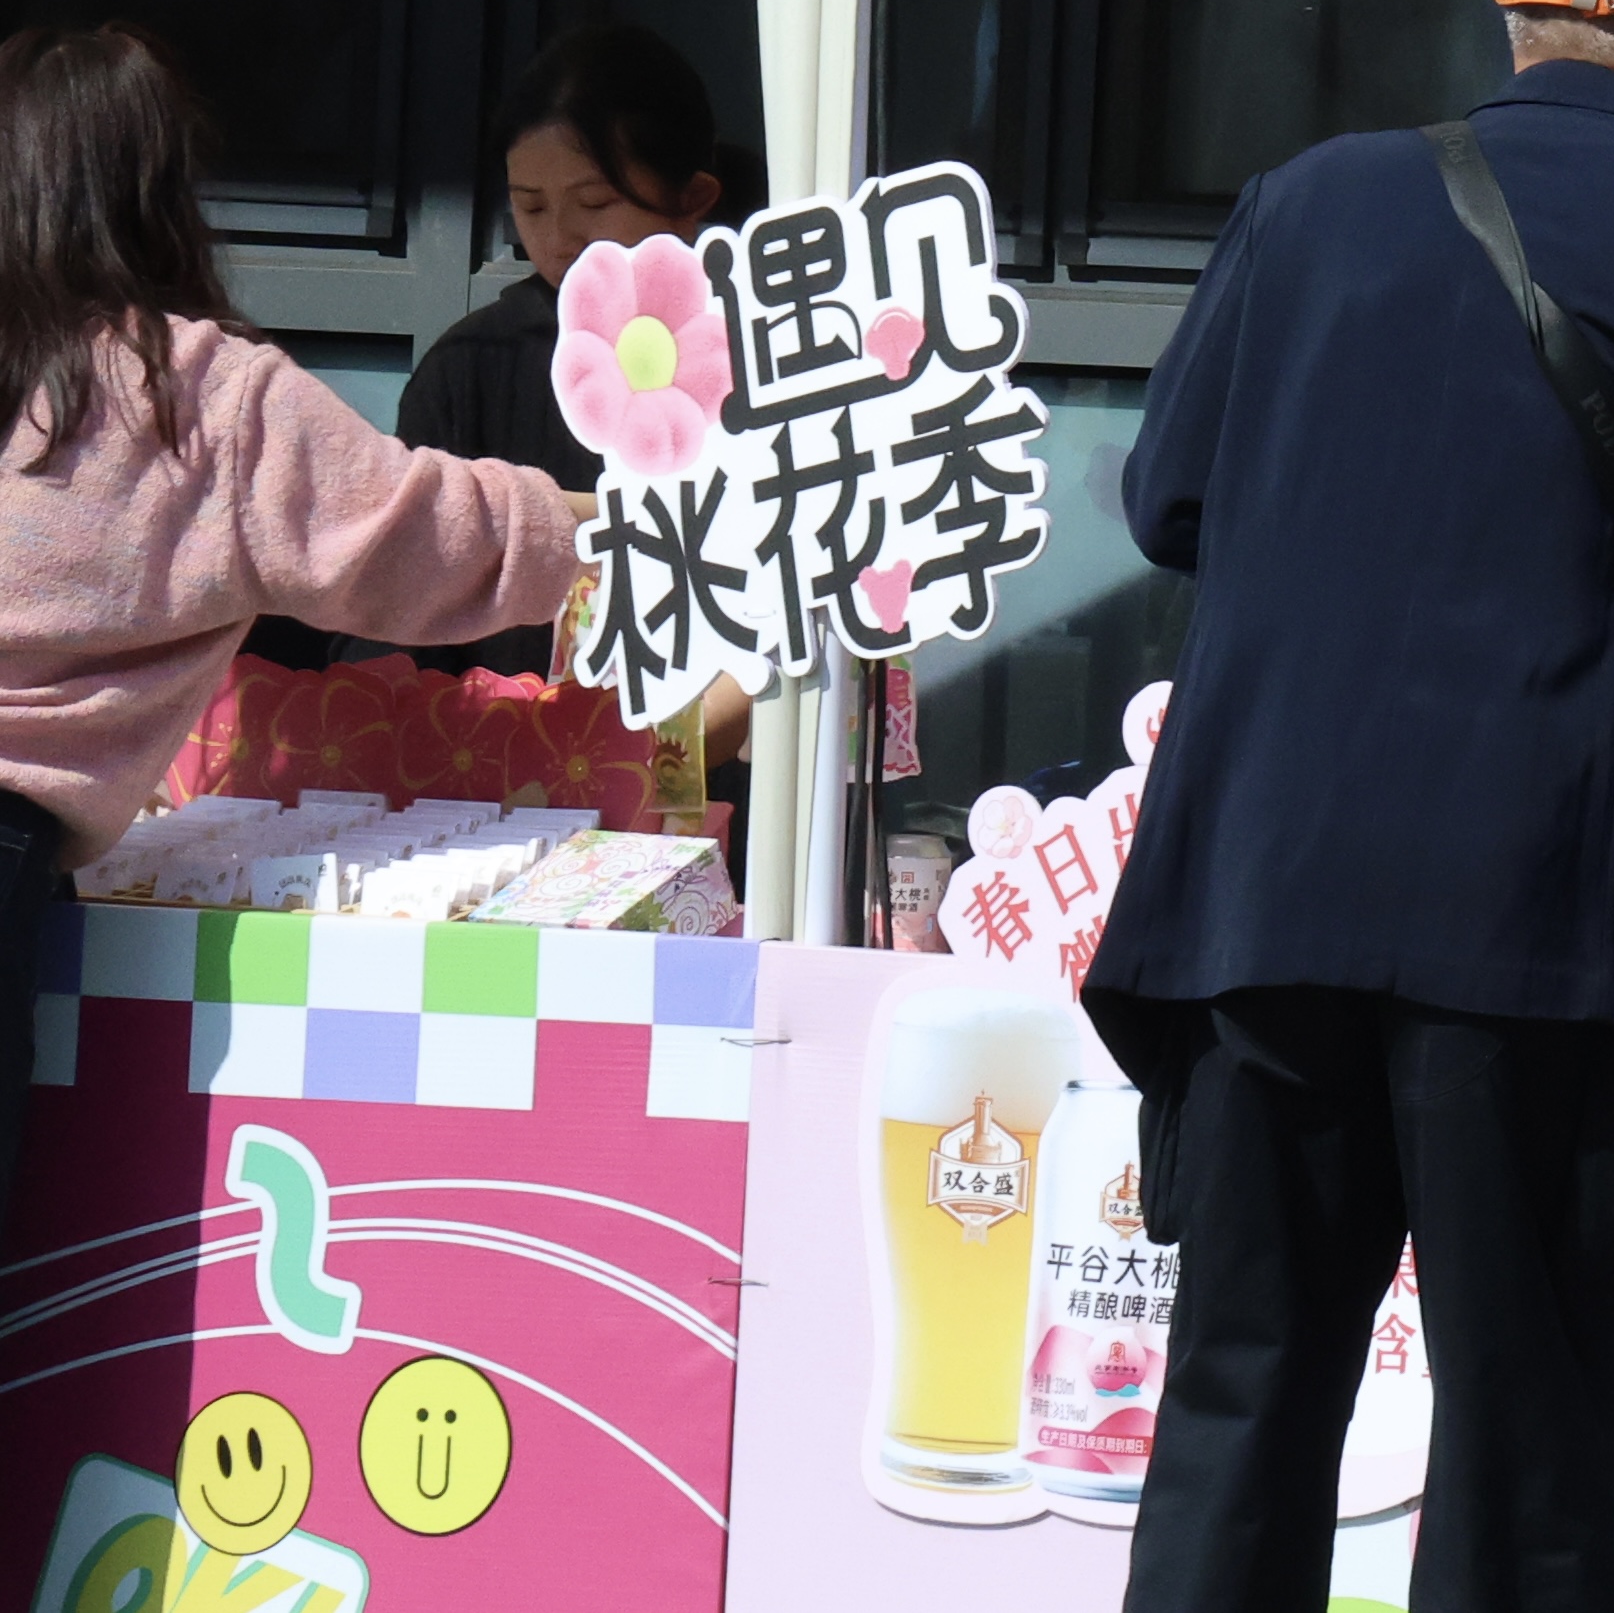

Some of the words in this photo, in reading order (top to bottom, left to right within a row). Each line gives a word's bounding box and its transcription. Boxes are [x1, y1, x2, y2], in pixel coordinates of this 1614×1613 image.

[703, 174, 1042, 434] 遇见
[587, 371, 1045, 716] 桃花季
[943, 1170, 1015, 1196] 双合盛
[1067, 1289, 1175, 1325] 精酿啤酒
